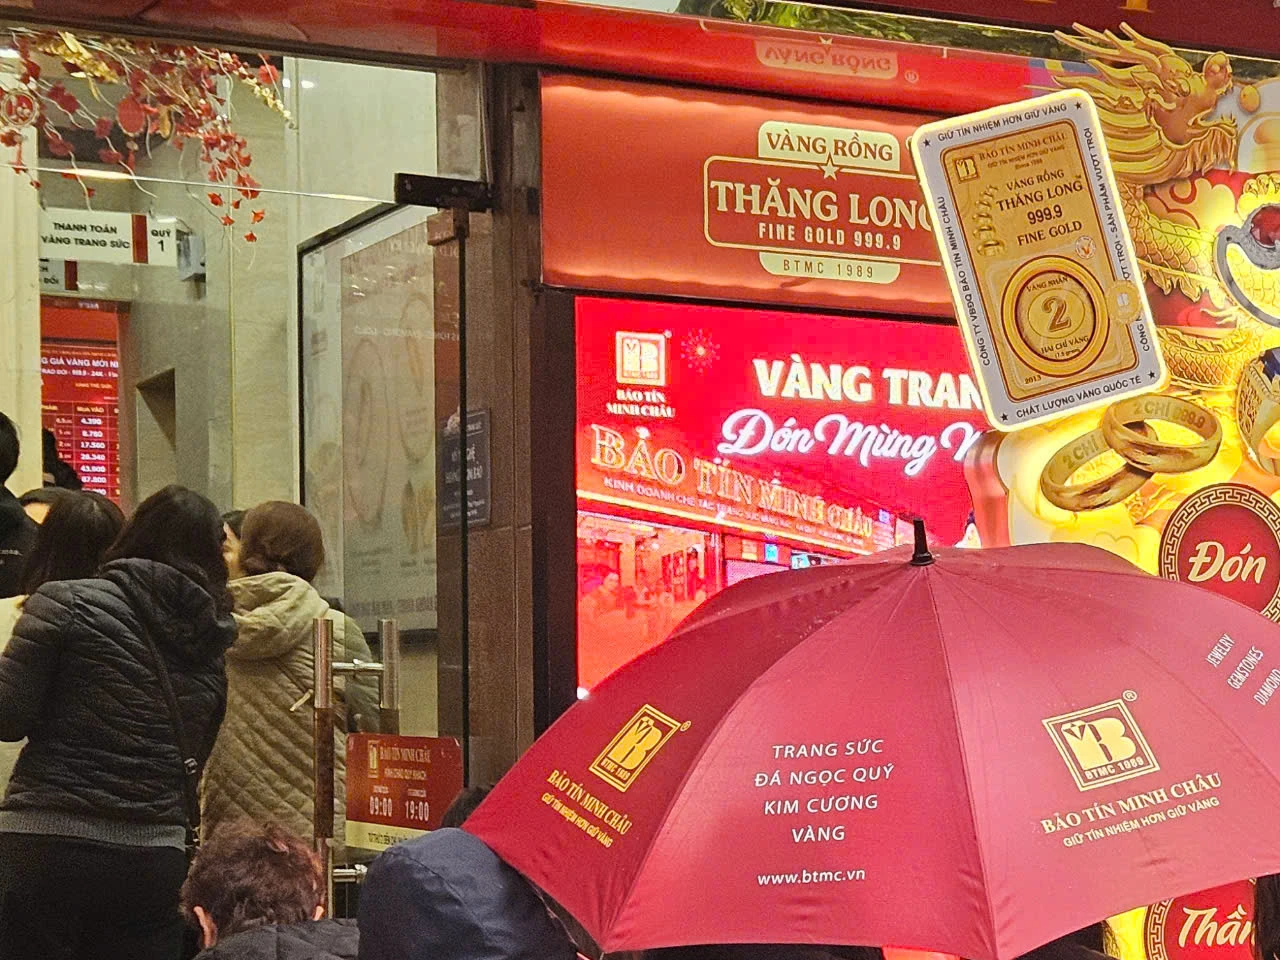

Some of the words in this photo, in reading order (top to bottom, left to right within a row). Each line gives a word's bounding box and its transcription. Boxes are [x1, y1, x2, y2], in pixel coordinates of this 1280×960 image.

[938, 129, 955, 142] GIỮ
[957, 126, 972, 139] TÍN
[973, 120, 1001, 135] NHIỆM
[1003, 114, 1023, 127] HƠN
[1024, 108, 1041, 122] GIỮ
[1042, 103, 1067, 116] VÀNG
[766, 129, 826, 154] VÀNG
[833, 136, 893, 161] RỒNG
[1006, 177, 1035, 191] VÀNG
[1036, 168, 1065, 184] RỒNG
[710, 177, 838, 222] THĂNG
[996, 190, 1043, 211] THĂNG
[1046, 179, 1083, 199] LONG
[935, 196, 951, 224] CHÂU
[1027, 204, 1063, 225] 999.9
[53, 222, 87, 231] THANH
[90, 223, 117, 234] TOÁN
[758, 222, 795, 241] FINE
[804, 226, 845, 245] GOLD
[854, 231, 901, 250] 999.9
[943, 225, 958, 251] MINH
[1016, 229, 1046, 246] FINE
[1049, 220, 1082, 238] GOLD
[40, 235, 71, 245] VÀNG
[74, 237, 107, 247] TRANG
[110, 237, 130, 249] SỨC
[158, 240, 165, 252] 1
[783, 259, 825, 274] BTMC
[837, 263, 874, 278] 1989
[953, 252, 963, 268] TÍN
[958, 269, 970, 292] BẢO
[1042, 296, 1072, 332] 2
[972, 323, 981, 335] TY
[50, 357, 65, 366] GIÁ
[66, 358, 90, 367] VÀNG
[976, 337, 991, 366] CÔNG
[753, 353, 873, 403] VÀNG
[1016, 403, 1042, 418] CHẤT
[1042, 396, 1076, 413] LƯỢNG
[1076, 387, 1102, 402] VÀNG
[1102, 378, 1129, 393] QUỐC
[1128, 374, 1142, 387] TẾ
[1133, 403, 1141, 414] 2
[717, 407, 815, 458] Đón
[815, 413, 938, 476] Mừng
[590, 425, 686, 484] BẢO
[694, 457, 754, 503] TÍN
[1187, 541, 1267, 584] Đón
[1204, 633, 1236, 668] JEWELRY
[1227, 645, 1265, 690] GEMSTONES
[772, 741, 839, 760] TRANG
[845, 738, 885, 755] SỨC
[754, 769, 782, 788] ĐÁ
[789, 767, 846, 787] NGỌC
[853, 763, 895, 782] QUÝ
[1084, 765, 1117, 781] BTMC
[369, 796, 393, 817] 09:00
[405, 800, 430, 821] 19:00
[547, 769, 570, 791] BẢO
[567, 782, 586, 804] TÍN
[581, 790, 608, 820] MINH
[604, 804, 633, 835] CHÂU
[764, 798, 800, 815] KIM
[806, 794, 879, 813] CƯƠNG
[1040, 811, 1083, 835] BẢO
[1084, 800, 1116, 823] TÍN
[1116, 789, 1170, 815] MINH
[1171, 772, 1223, 798] CHÂU
[792, 823, 846, 843] VÀNG
[1063, 830, 1085, 848] GIỮ
[1084, 825, 1105, 842] TÍN
[1105, 816, 1140, 837] NHIỆM
[1140, 810, 1167, 828] HƠN
[1167, 802, 1189, 822] GIỮ
[1188, 795, 1220, 815] VÀNG
[757, 867, 866, 887] www.btmc.vn
